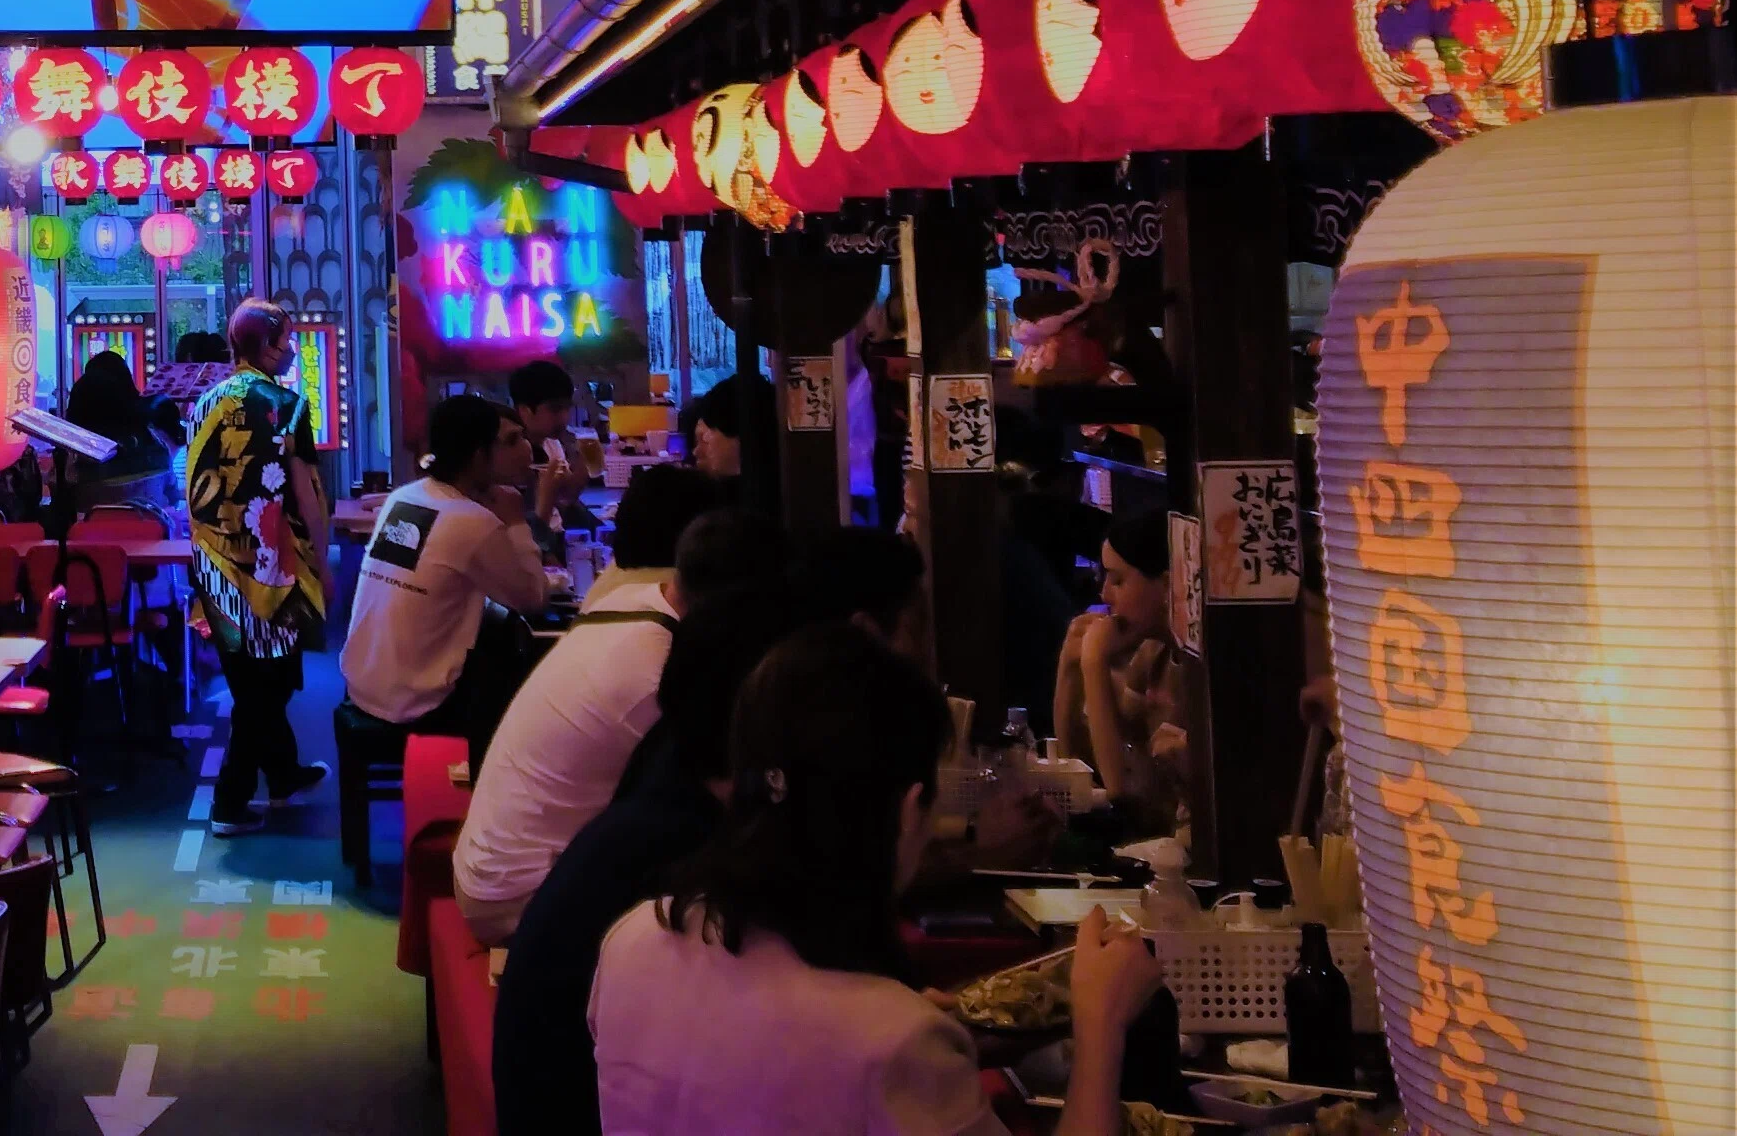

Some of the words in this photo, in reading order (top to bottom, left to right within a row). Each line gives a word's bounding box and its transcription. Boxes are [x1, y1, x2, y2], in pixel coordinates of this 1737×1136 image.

[437, 184, 600, 235] NAN
[443, 240, 600, 288] KURU
[445, 293, 602, 339] NAISA
[1232, 471, 1267, 585] おにぎり
